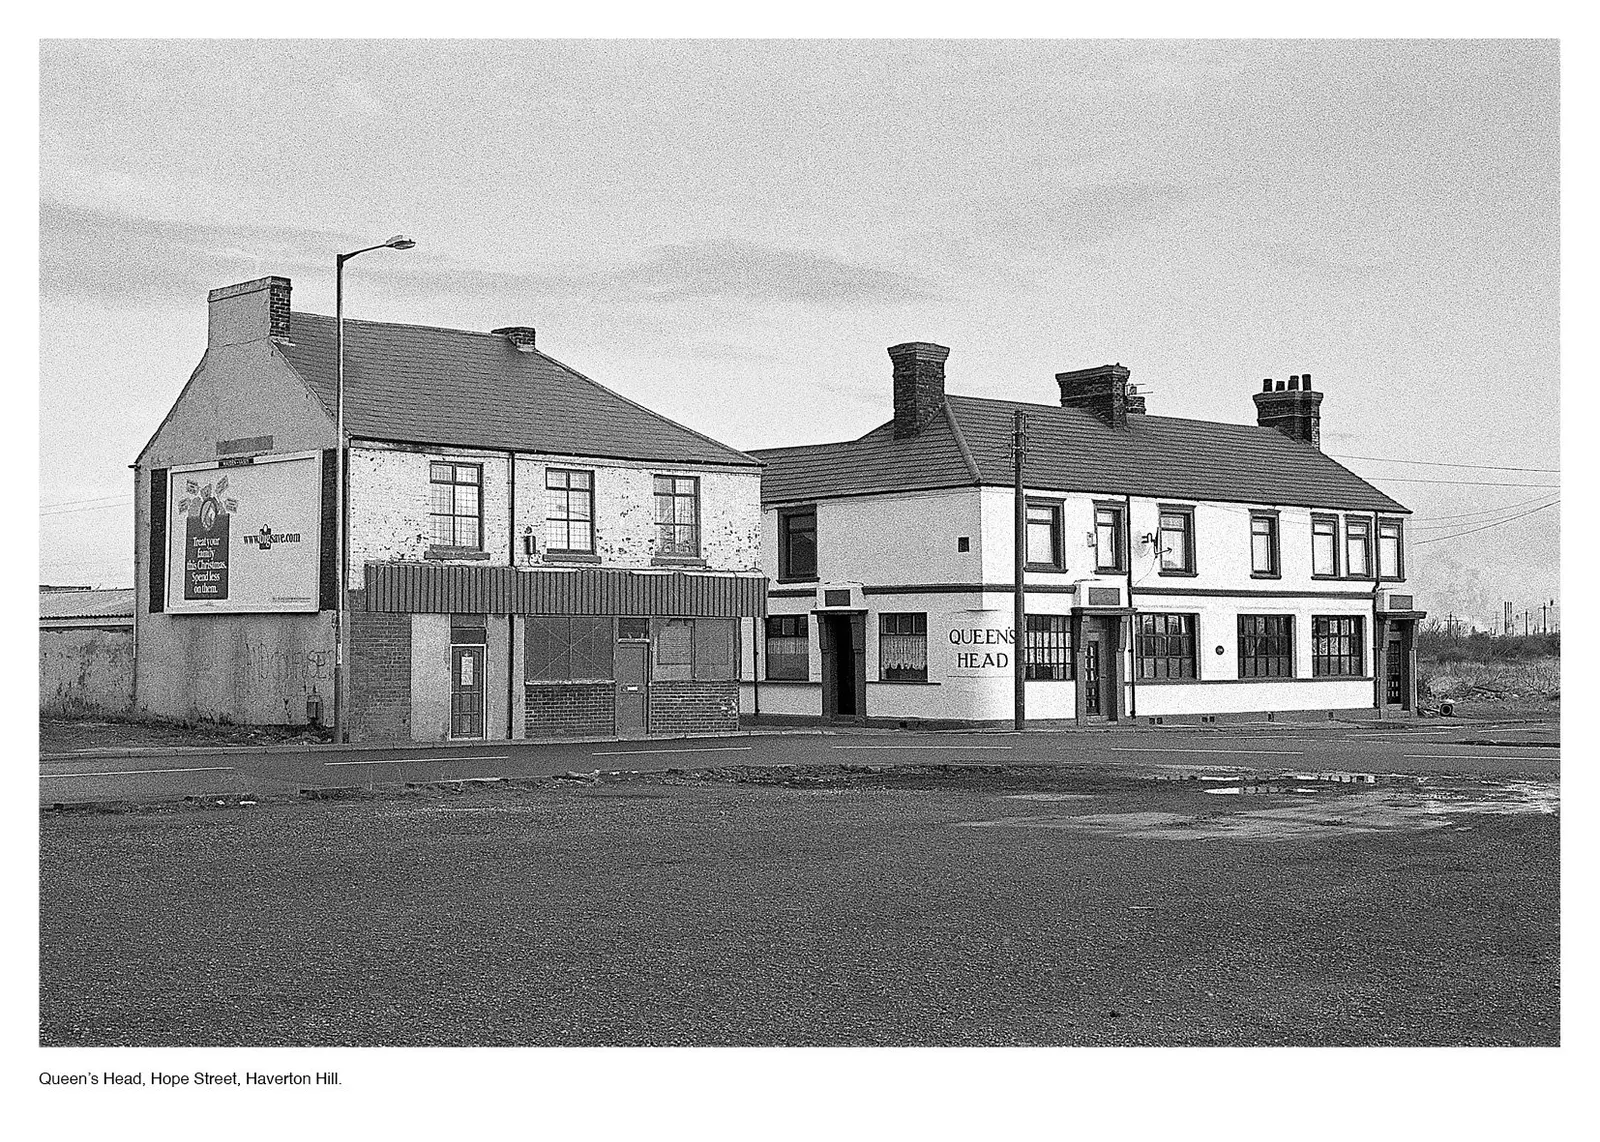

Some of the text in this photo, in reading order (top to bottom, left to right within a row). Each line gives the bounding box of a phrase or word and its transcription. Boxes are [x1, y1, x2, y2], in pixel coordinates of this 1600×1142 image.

[193, 536, 220, 549] Treat your
[197, 547, 216, 560] family
[187, 559, 197, 570] this
[192, 571, 221, 584] Spend less
[193, 582, 218, 594] on them.
[949, 626, 1015, 645] QUEEN'S
[957, 652, 1009, 668] HEAD
